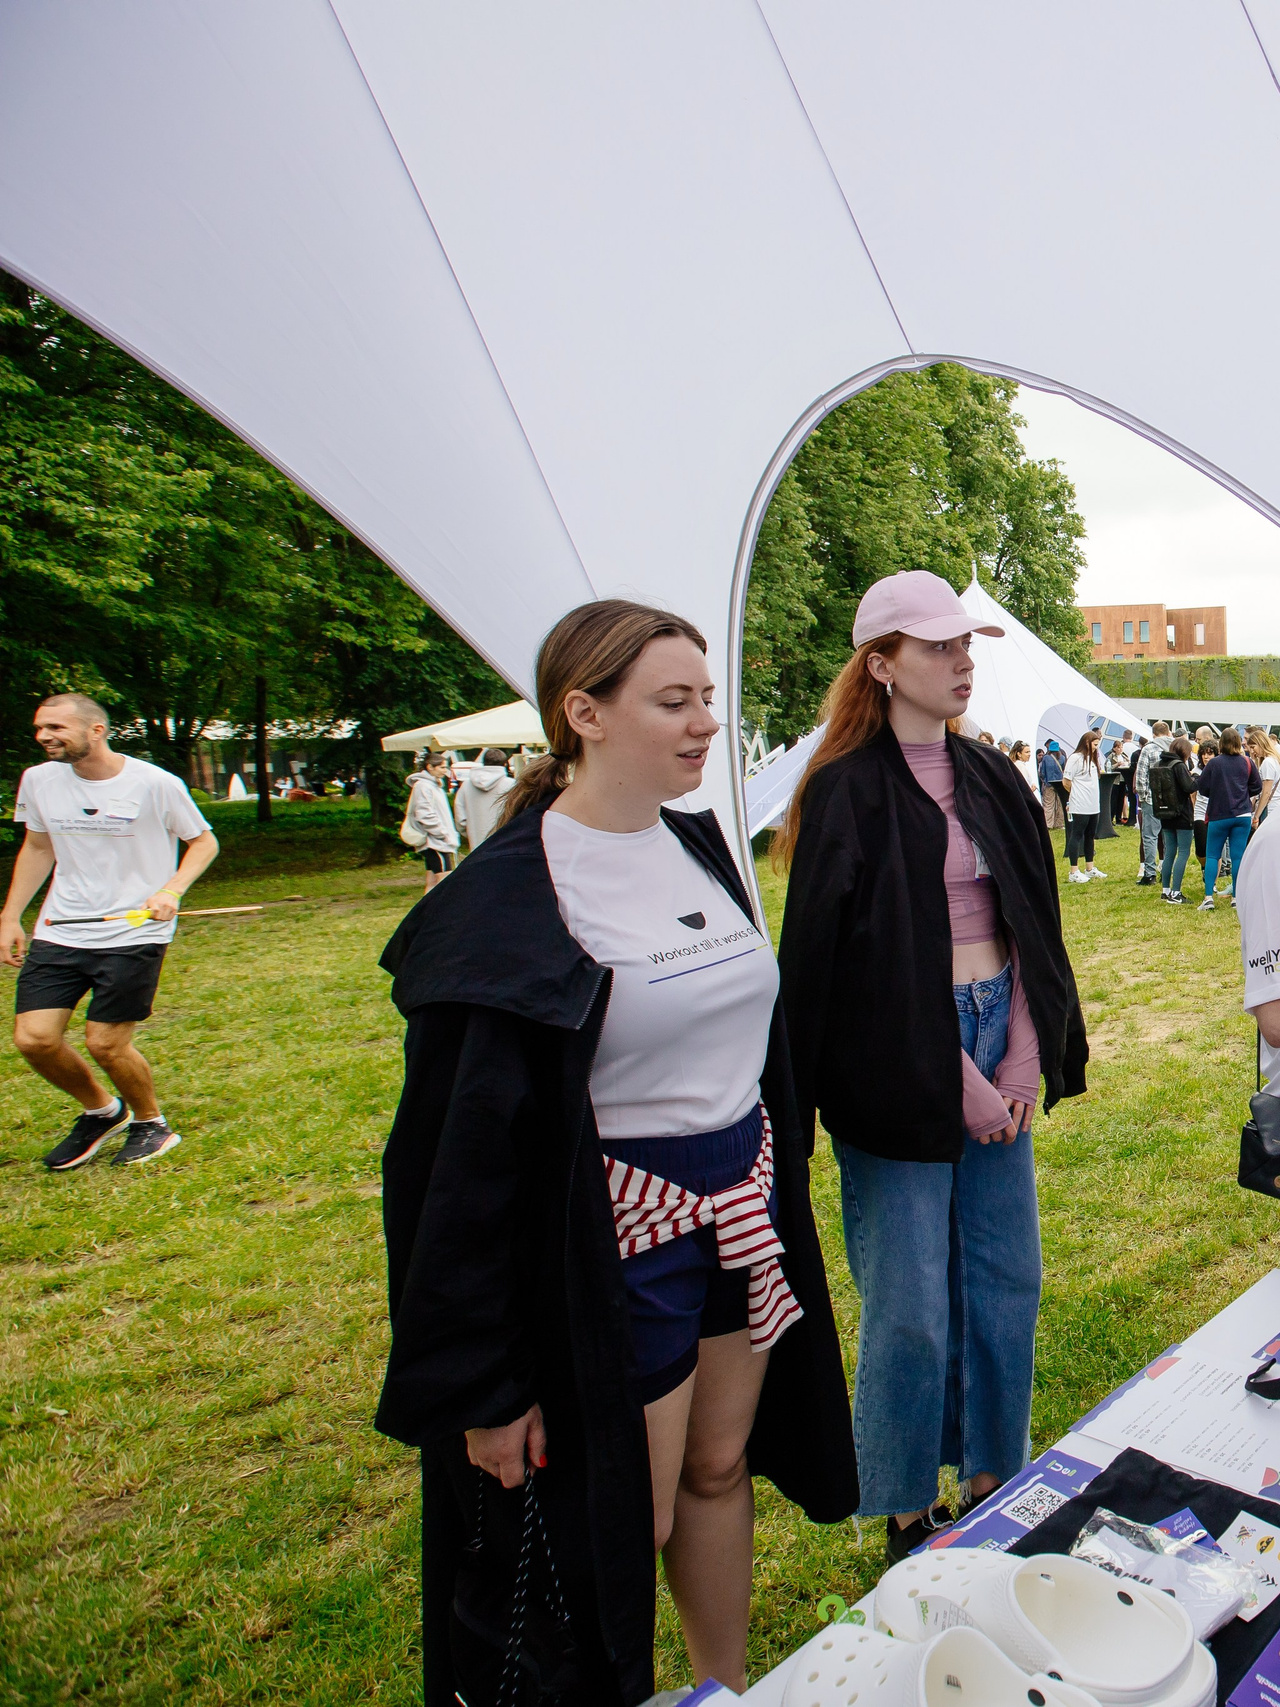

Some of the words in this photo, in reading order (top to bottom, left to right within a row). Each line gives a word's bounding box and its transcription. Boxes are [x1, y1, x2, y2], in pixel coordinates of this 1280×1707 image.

[647, 943, 702, 965] Workout
[700, 938, 714, 951] till
[711, 937, 723, 948] it
[721, 930, 748, 944] works
